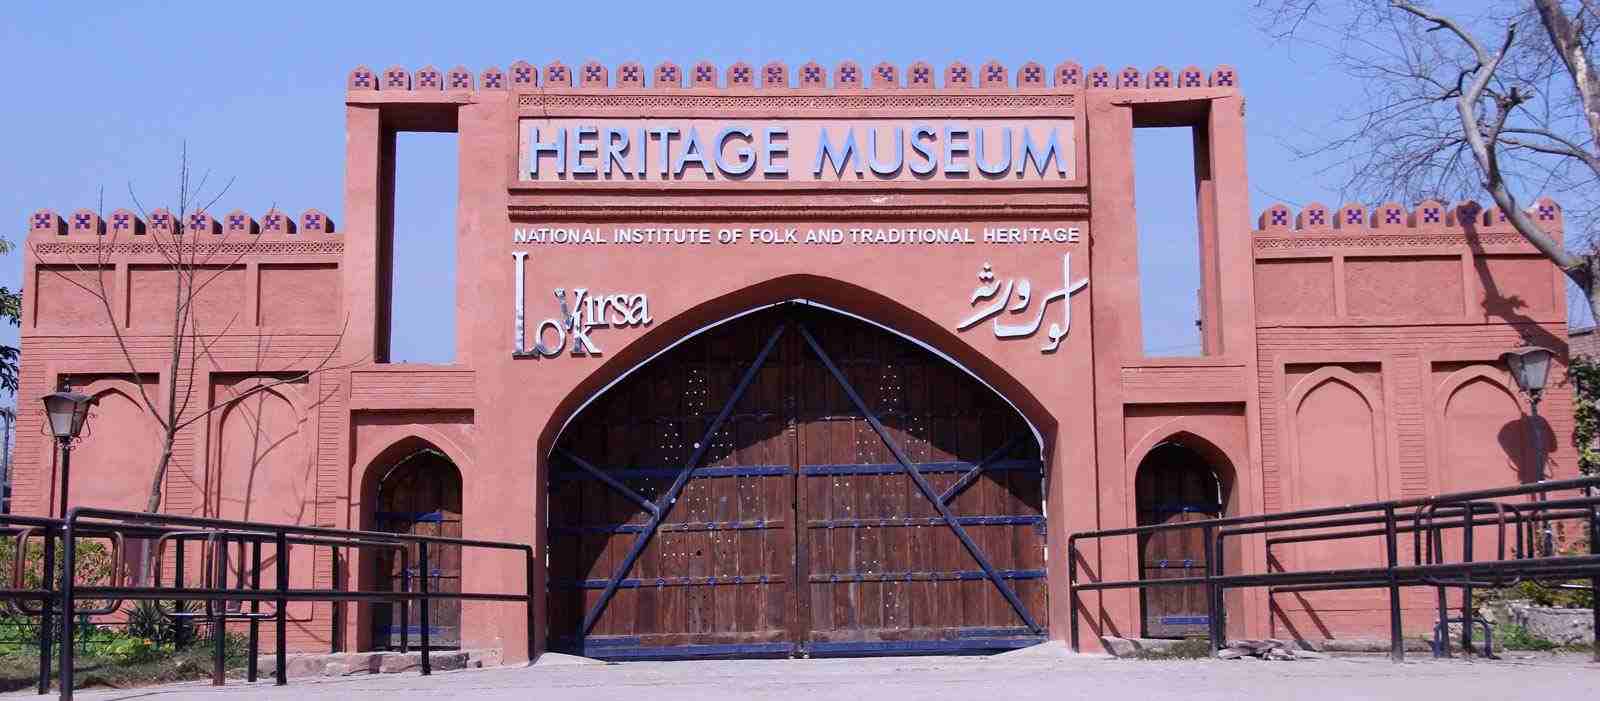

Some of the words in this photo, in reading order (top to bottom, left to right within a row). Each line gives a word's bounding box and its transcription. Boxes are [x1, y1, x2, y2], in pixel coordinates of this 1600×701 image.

[528, 126, 789, 179] HERITAGE
[813, 126, 1066, 179] MUSEUM
[513, 228, 607, 244] NATIONAL
[614, 228, 711, 244] INSTITUTE
[718, 228, 744, 244] OF
[749, 228, 798, 244] FOLK
[804, 228, 844, 244] AND
[849, 228, 976, 244] TRADITIONAL
[983, 228, 1080, 244] HERITAGE
[511, 251, 602, 359] Lok
